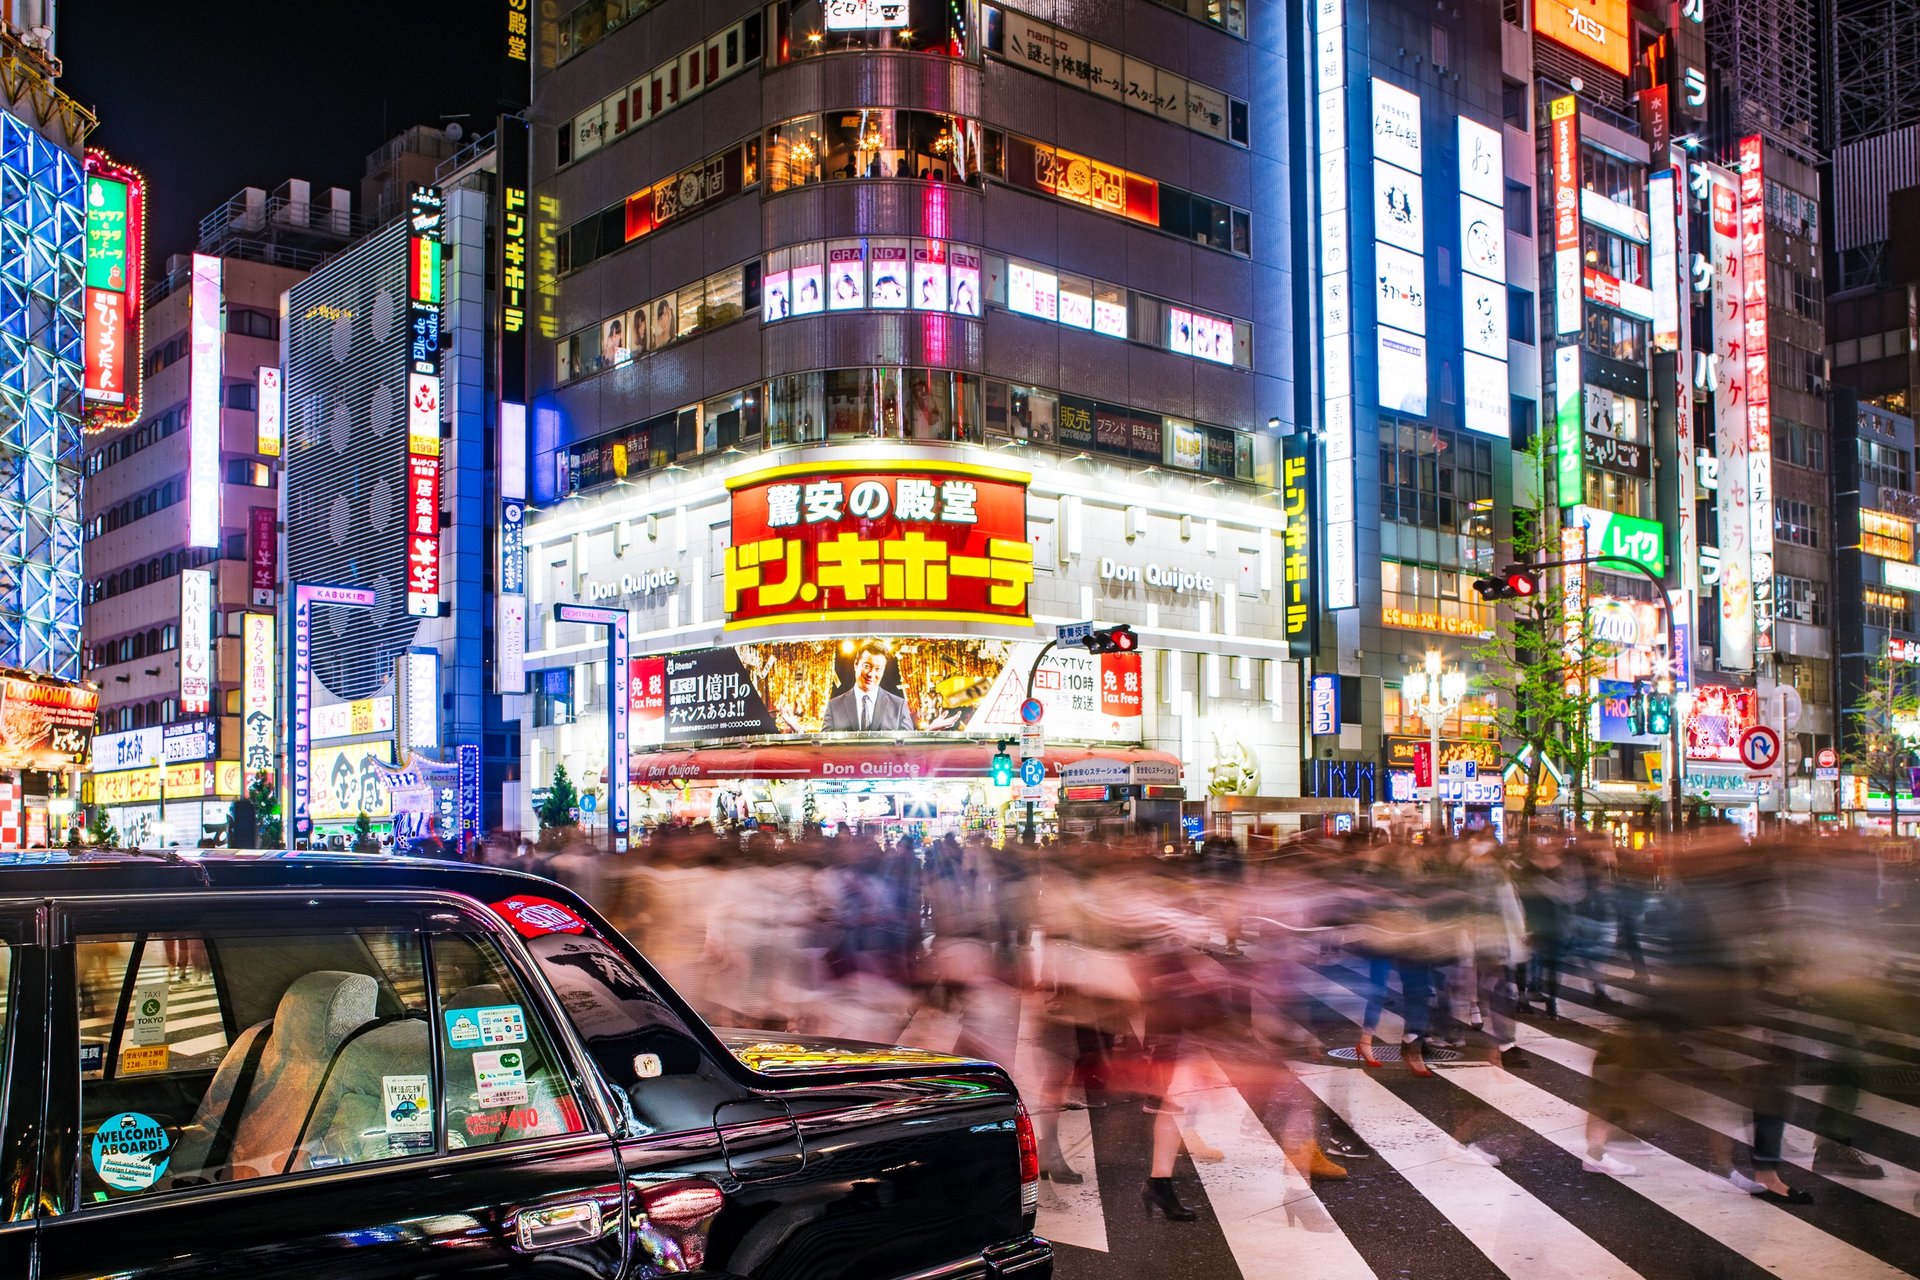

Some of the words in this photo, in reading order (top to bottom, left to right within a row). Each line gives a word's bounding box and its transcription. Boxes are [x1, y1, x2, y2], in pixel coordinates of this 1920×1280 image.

[1027, 28, 1068, 51] namco
[1555, 102, 1571, 116] 8F
[1651, 97, 1663, 153] 水上ビル
[89, 229, 122, 242] サラダ
[88, 247, 123, 260] スイーツ
[1328, 224, 1343, 325] 北の家族
[426, 304, 440, 313] Club
[415, 318, 426, 334] de
[425, 314, 438, 351] Castle
[414, 335, 426, 361] Elle
[1060, 405, 1091, 430] 販売
[1097, 418, 1127, 436] ブランド
[1132, 424, 1160, 444] 時計
[417, 444, 432, 453] 199
[627, 435, 649, 452] 時計
[1561, 425, 1577, 473] レイク
[415, 479, 433, 534] 居楽屋
[766, 478, 979, 528] 驚安の殿堂
[1613, 526, 1658, 562] レイク
[590, 579, 617, 601] Don
[621, 567, 677, 596] Quijote
[1101, 556, 1140, 583] Don
[1145, 563, 1215, 594] Quijote
[316, 588, 366, 602] KABUKI町
[1674, 628, 1684, 677] PROMISE
[296, 619, 308, 731] GODZILLA
[1102, 669, 1139, 692] 免税
[6, 681, 67, 706] OKONOMI
[69, 688, 99, 708] YAKI
[631, 674, 662, 698] 免税
[696, 672, 751, 703] 1億円の
[186, 700, 204, 712] B1
[631, 697, 645, 709] Tax
[645, 696, 662, 708] Free
[1072, 694, 1094, 712] 放送
[1103, 691, 1119, 704] Tax
[1120, 692, 1139, 705] Free
[1317, 692, 1331, 732] ダイコク
[317, 711, 346, 734] 鳥メロ
[354, 716, 369, 732] 199
[247, 711, 273, 770] 金の蔵
[297, 743, 308, 798] ROAD
[649, 765, 665, 777] Don
[667, 764, 700, 777] Quijote
[822, 762, 855, 775] Don
[860, 762, 920, 779] Quijote
[1026, 765, 1036, 782] P
[1067, 767, 1124, 777] 安全安心ステーション
[1136, 766, 1176, 775] 安全安心ステーション
[1467, 762, 1474, 772] P
[331, 752, 384, 813] 金の蔵
[462, 750, 476, 815] カラオケ
[440, 787, 455, 841] カラオケ
[463, 819, 476, 829] B1
[143, 991, 161, 999] TAXI
[146, 1002, 157, 1014] &
[137, 1016, 164, 1025] TOKYO
[396, 1093, 417, 1101] TAXI
[97, 1126, 164, 1144] WELCOME
[100, 1138, 162, 1156] ABOARD!
[103, 1165, 124, 1174] Foreign
[125, 1167, 152, 1177] Language
